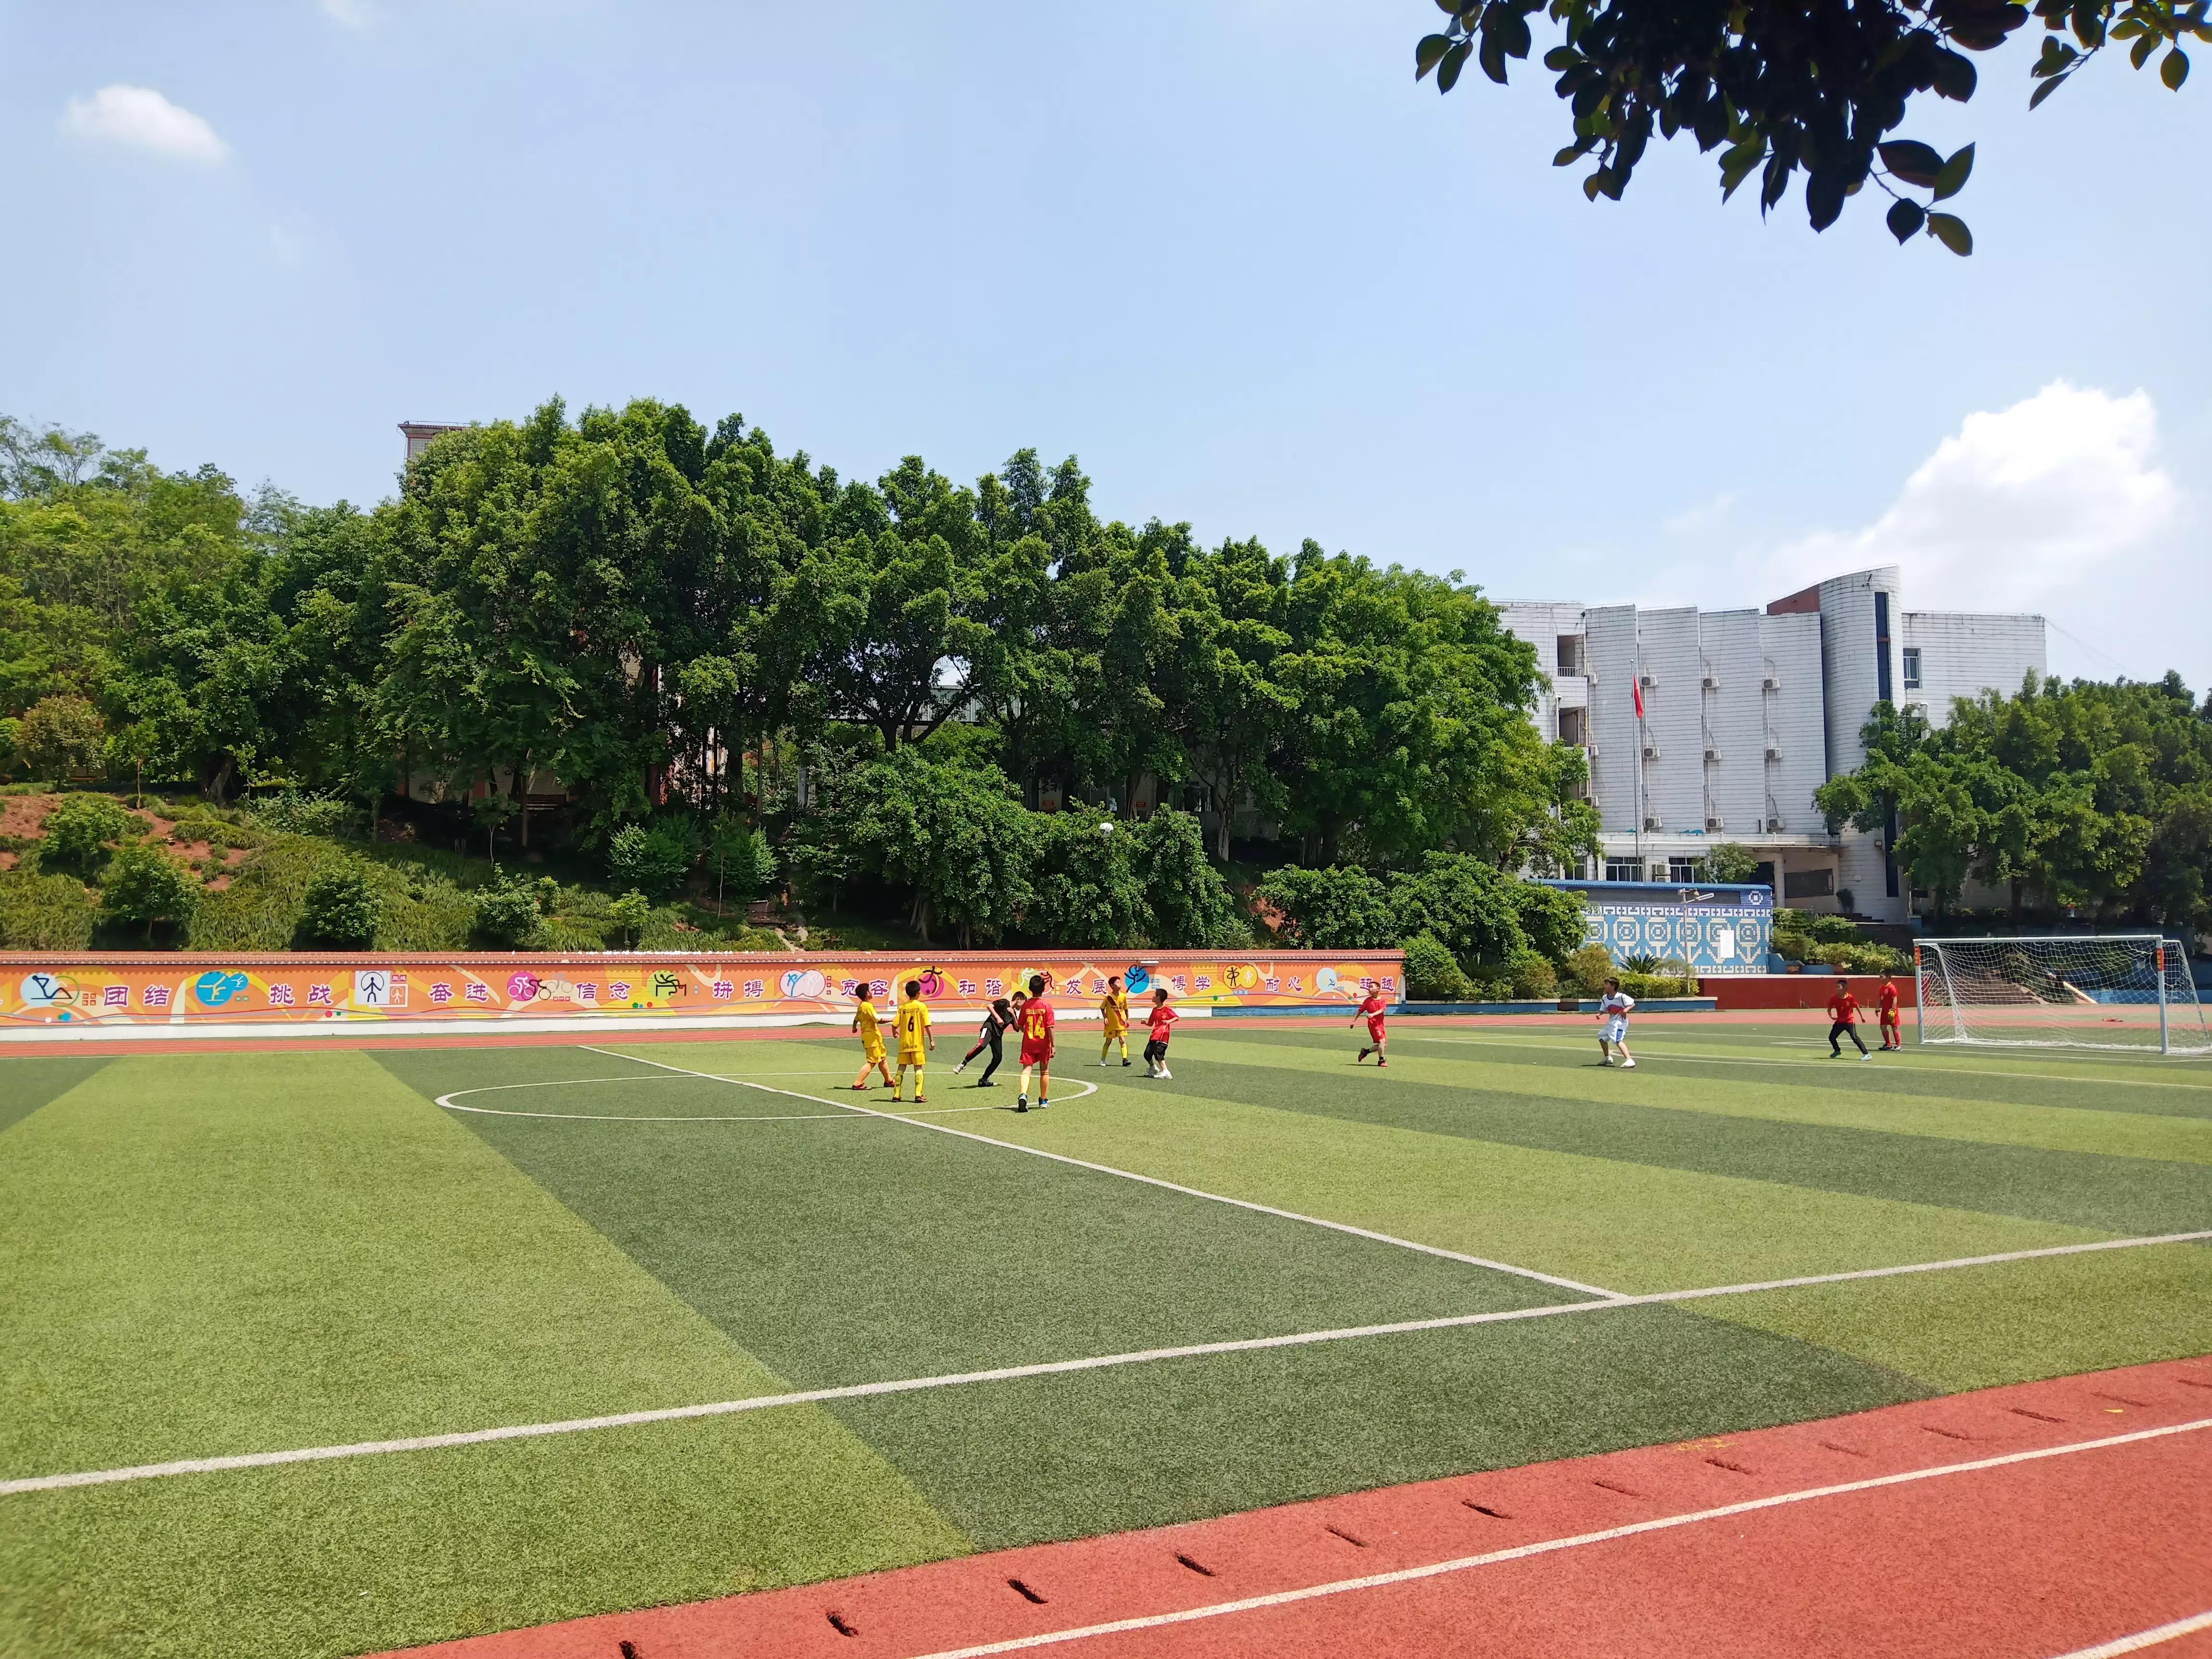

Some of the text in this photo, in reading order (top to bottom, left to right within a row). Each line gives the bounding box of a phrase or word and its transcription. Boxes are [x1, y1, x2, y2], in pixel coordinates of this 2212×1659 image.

[104, 986, 170, 1006] 团结
[270, 985, 332, 1004] 挑战
[430, 983, 488, 1002] 奋进
[577, 982, 630, 999] 信念
[714, 981, 763, 998] 拼搏
[841, 979, 888, 996] 宽容
[960, 979, 1002, 995] 和谐
[1067, 979, 1107, 994] 发展
[1172, 976, 1210, 990] 博学
[1266, 976, 1302, 991] 耐心
[1360, 978, 1394, 991] 超越
[908, 1016, 914, 1032] 6
[1027, 1016, 1045, 1039] 14
